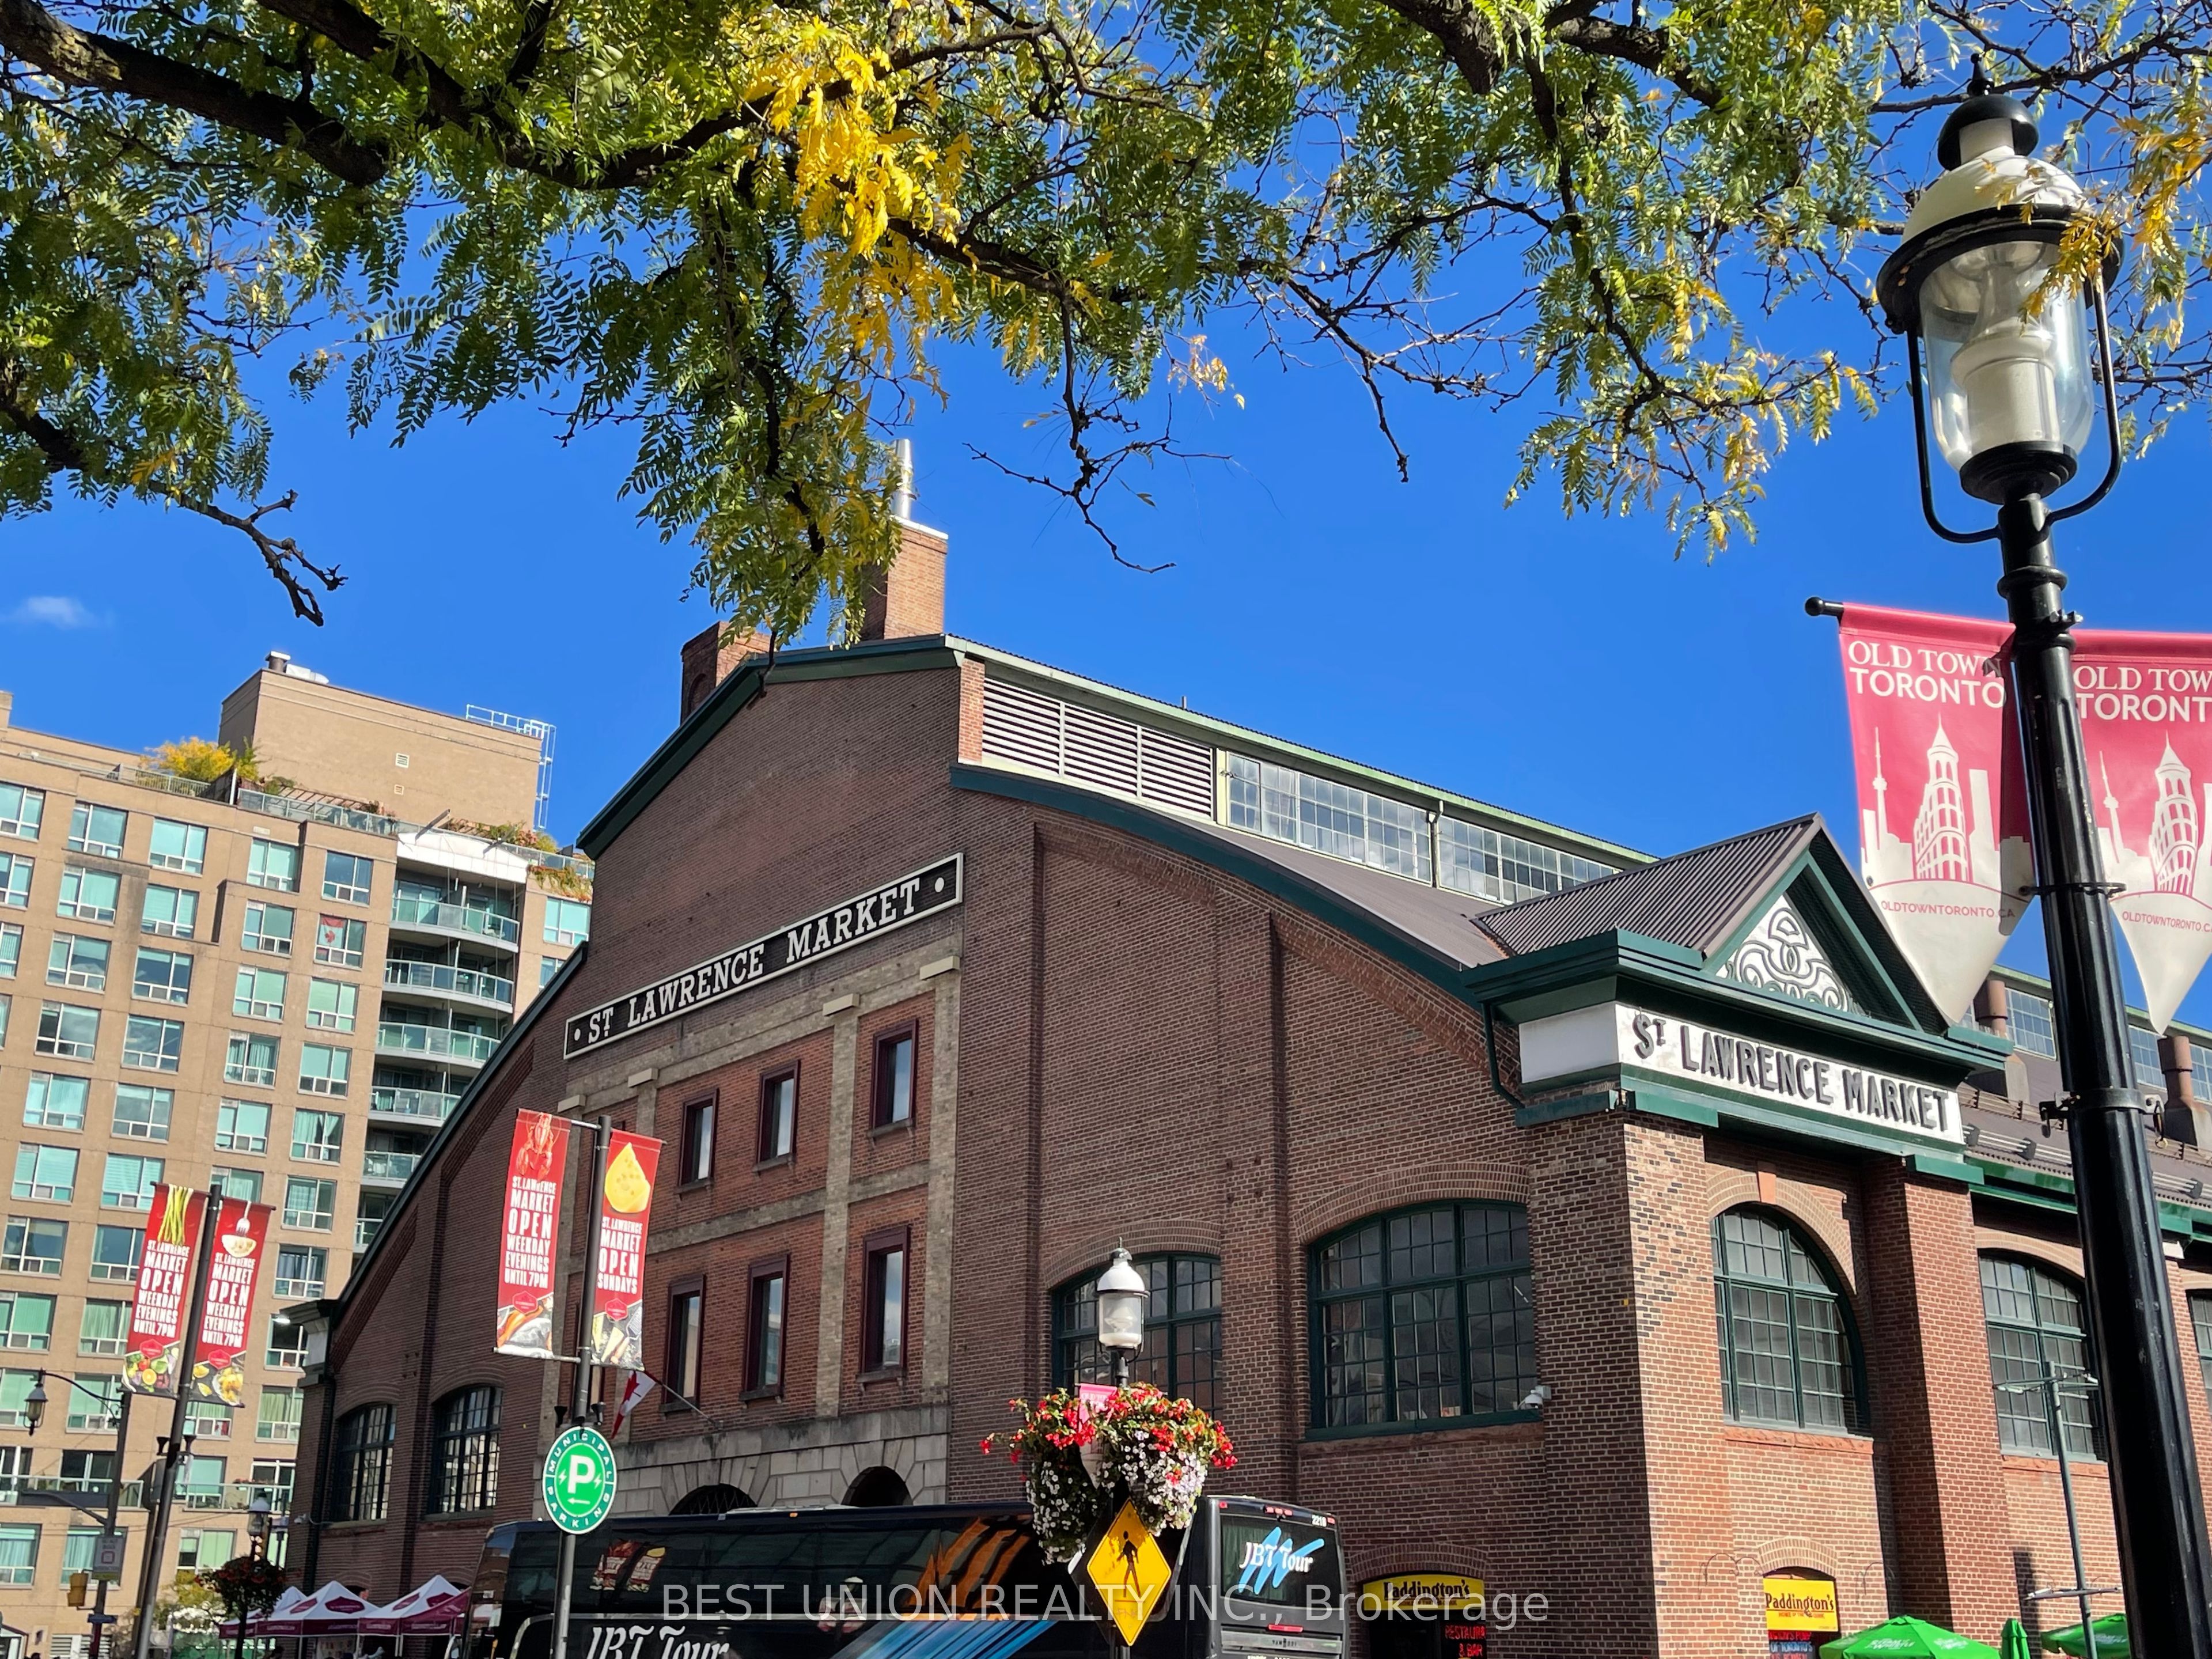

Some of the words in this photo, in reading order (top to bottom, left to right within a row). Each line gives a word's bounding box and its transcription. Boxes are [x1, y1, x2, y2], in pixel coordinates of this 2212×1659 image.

[1848, 640, 1912, 669] OLD
[1918, 648, 2002, 678] TOWN
[1849, 667, 2006, 709] TORONTO
[2074, 665, 2142, 690] OLD
[1881, 900, 2016, 918] OLDTOWNTORONTO.CA
[2122, 911, 2212, 933] OLDTOWNTORONTO.C
[627, 943, 764, 1028] LAWRENCE
[786, 877, 920, 964] MARKET
[1680, 1025, 1834, 1105] LAWRENCE
[1843, 1068, 1950, 1132] MARKET
[510, 1188, 555, 1214] MARKET
[508, 1209, 552, 1239] OPEN
[611, 1218, 643, 1235] LAWRENCE
[507, 1234, 551, 1256] WEEKDAY
[600, 1229, 642, 1253] MARKET
[144, 1251, 188, 1274] MARKET
[212, 1263, 253, 1285] MARKET
[505, 1251, 549, 1273] EVENINGS
[599, 1248, 639, 1278] OPEN
[141, 1268, 184, 1296] OPEN
[505, 1268, 528, 1286] UNTIL
[528, 1272, 548, 1289] 7PM
[597, 1272, 637, 1294] SUNDAYS
[139, 1289, 180, 1310] WEEKDAY
[209, 1279, 250, 1307] OPEN
[135, 1304, 178, 1324] EVENINGS
[206, 1301, 247, 1320] WEEKDAY
[134, 1319, 156, 1335] UNTIL
[156, 1321, 176, 1338] 7PM
[204, 1315, 244, 1335] EVENINGS
[202, 1330, 224, 1346] UNTIL
[224, 1334, 243, 1348] 7PM
[549, 1433, 612, 1479] MUNICIPAL
[567, 1455, 596, 1494] P
[547, 1486, 610, 1528] PARKING
[1239, 1542, 1277, 1569] JBT
[1279, 1546, 1313, 1573] Tour
[1384, 1579, 1470, 1603] Paddington's
[1765, 1593, 1834, 1617] Paddington's
